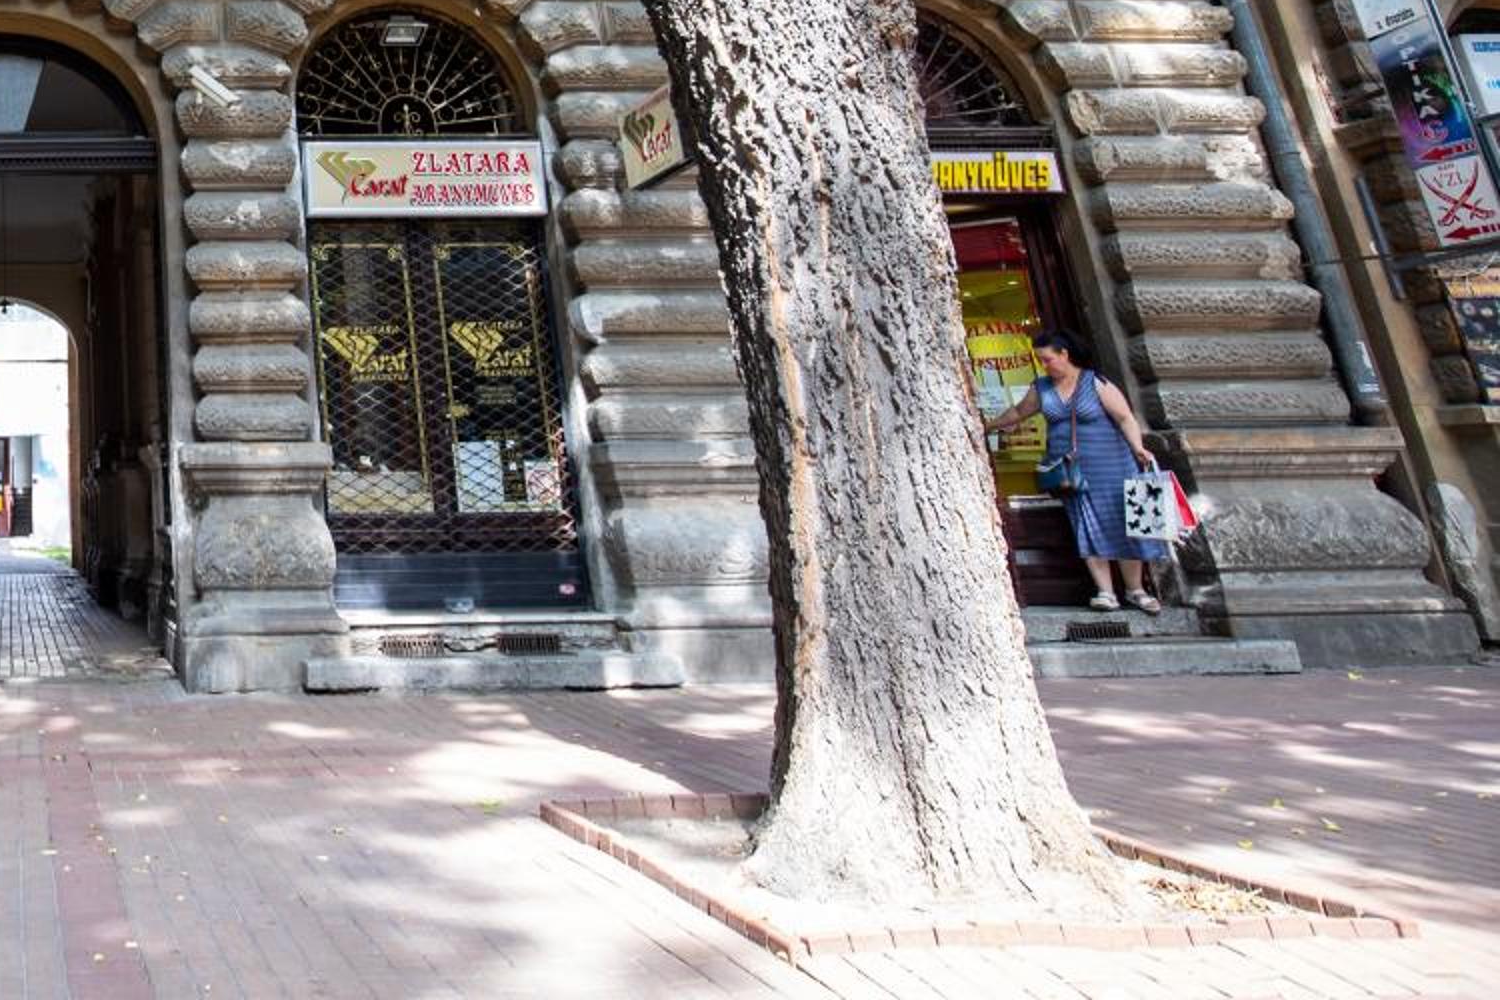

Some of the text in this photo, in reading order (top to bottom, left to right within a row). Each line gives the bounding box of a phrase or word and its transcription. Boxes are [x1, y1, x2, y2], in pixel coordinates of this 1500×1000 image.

[1392, 32, 1439, 119] OPTIKA
[412, 152, 532, 175] ZLATARA
[350, 174, 408, 198] Carat
